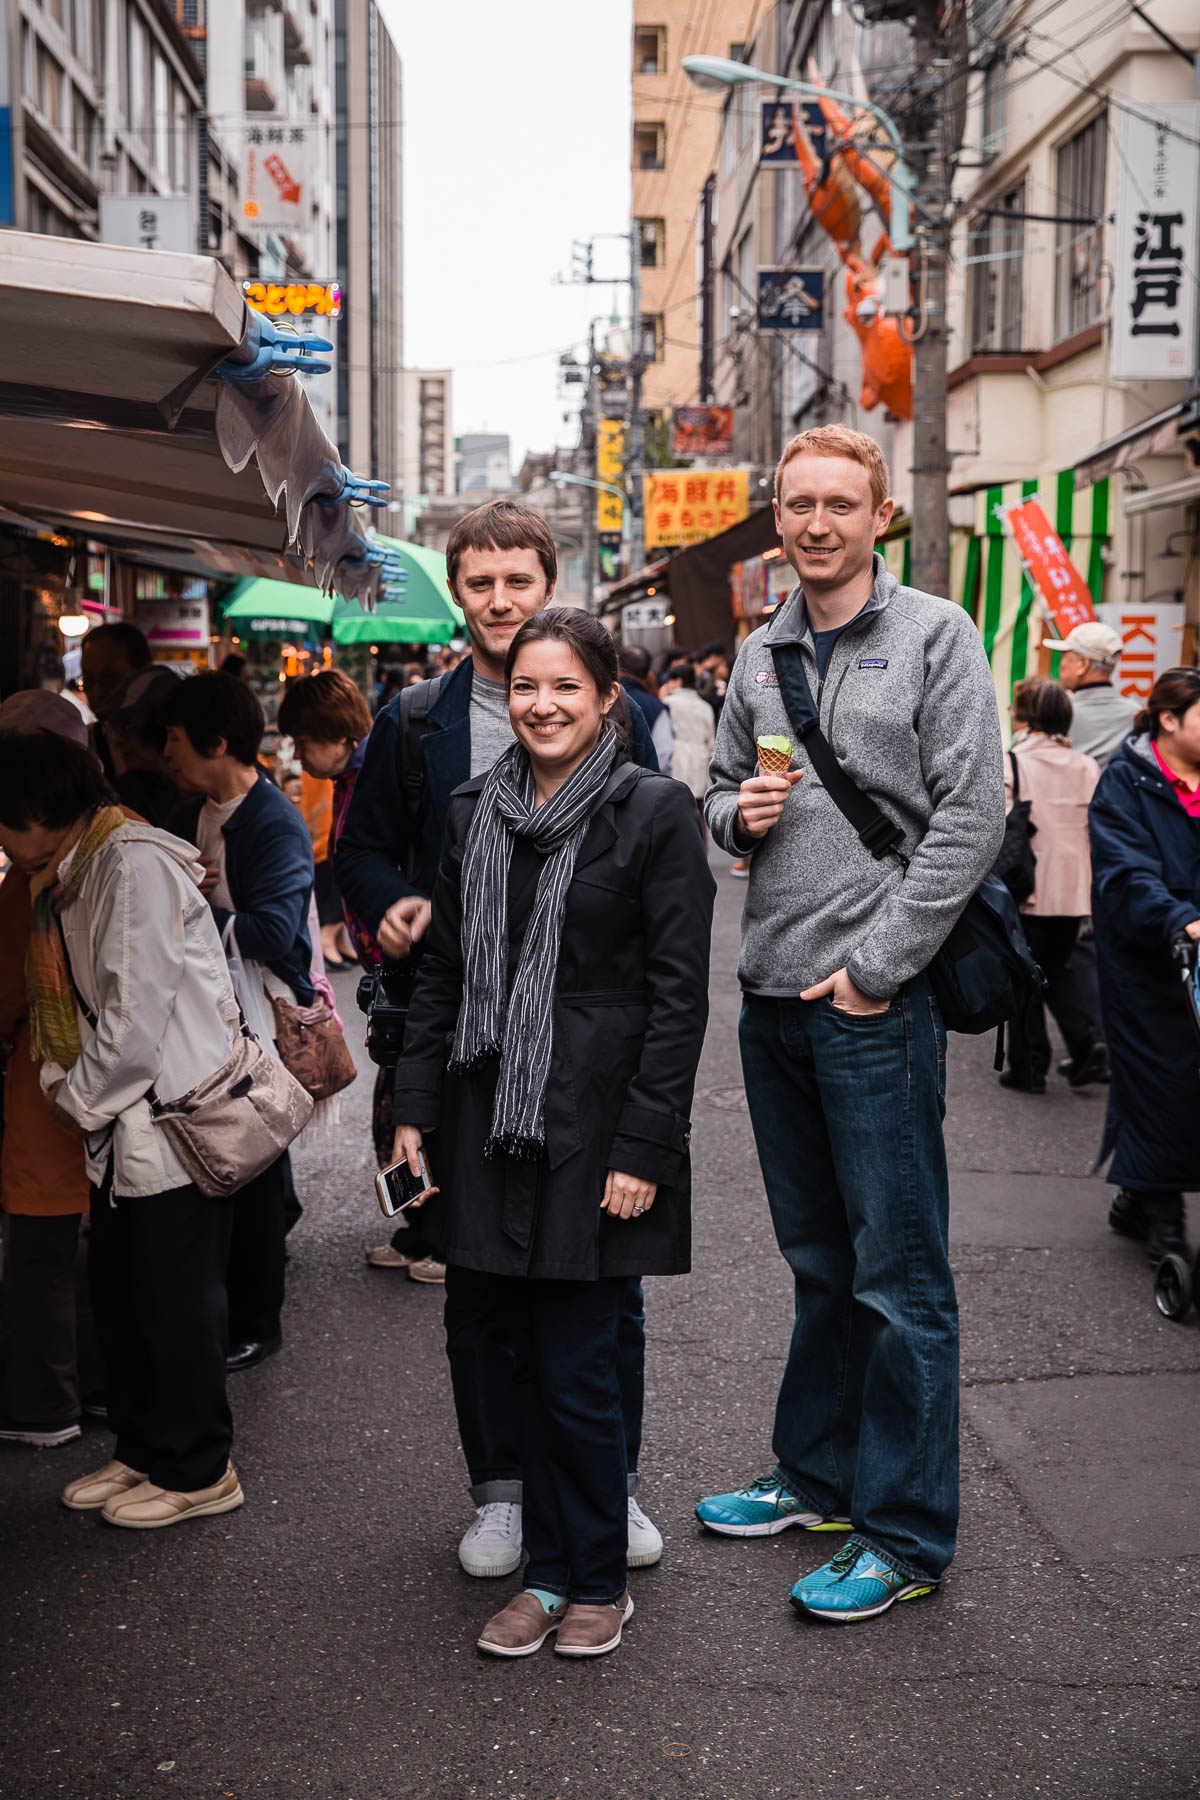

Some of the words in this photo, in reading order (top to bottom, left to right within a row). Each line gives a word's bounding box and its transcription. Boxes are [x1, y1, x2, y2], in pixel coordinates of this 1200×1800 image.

[1131, 212, 1184, 336] 江戸一
[654, 479, 736, 505] 海鮮丼
[1120, 616, 1155, 697] KIR
